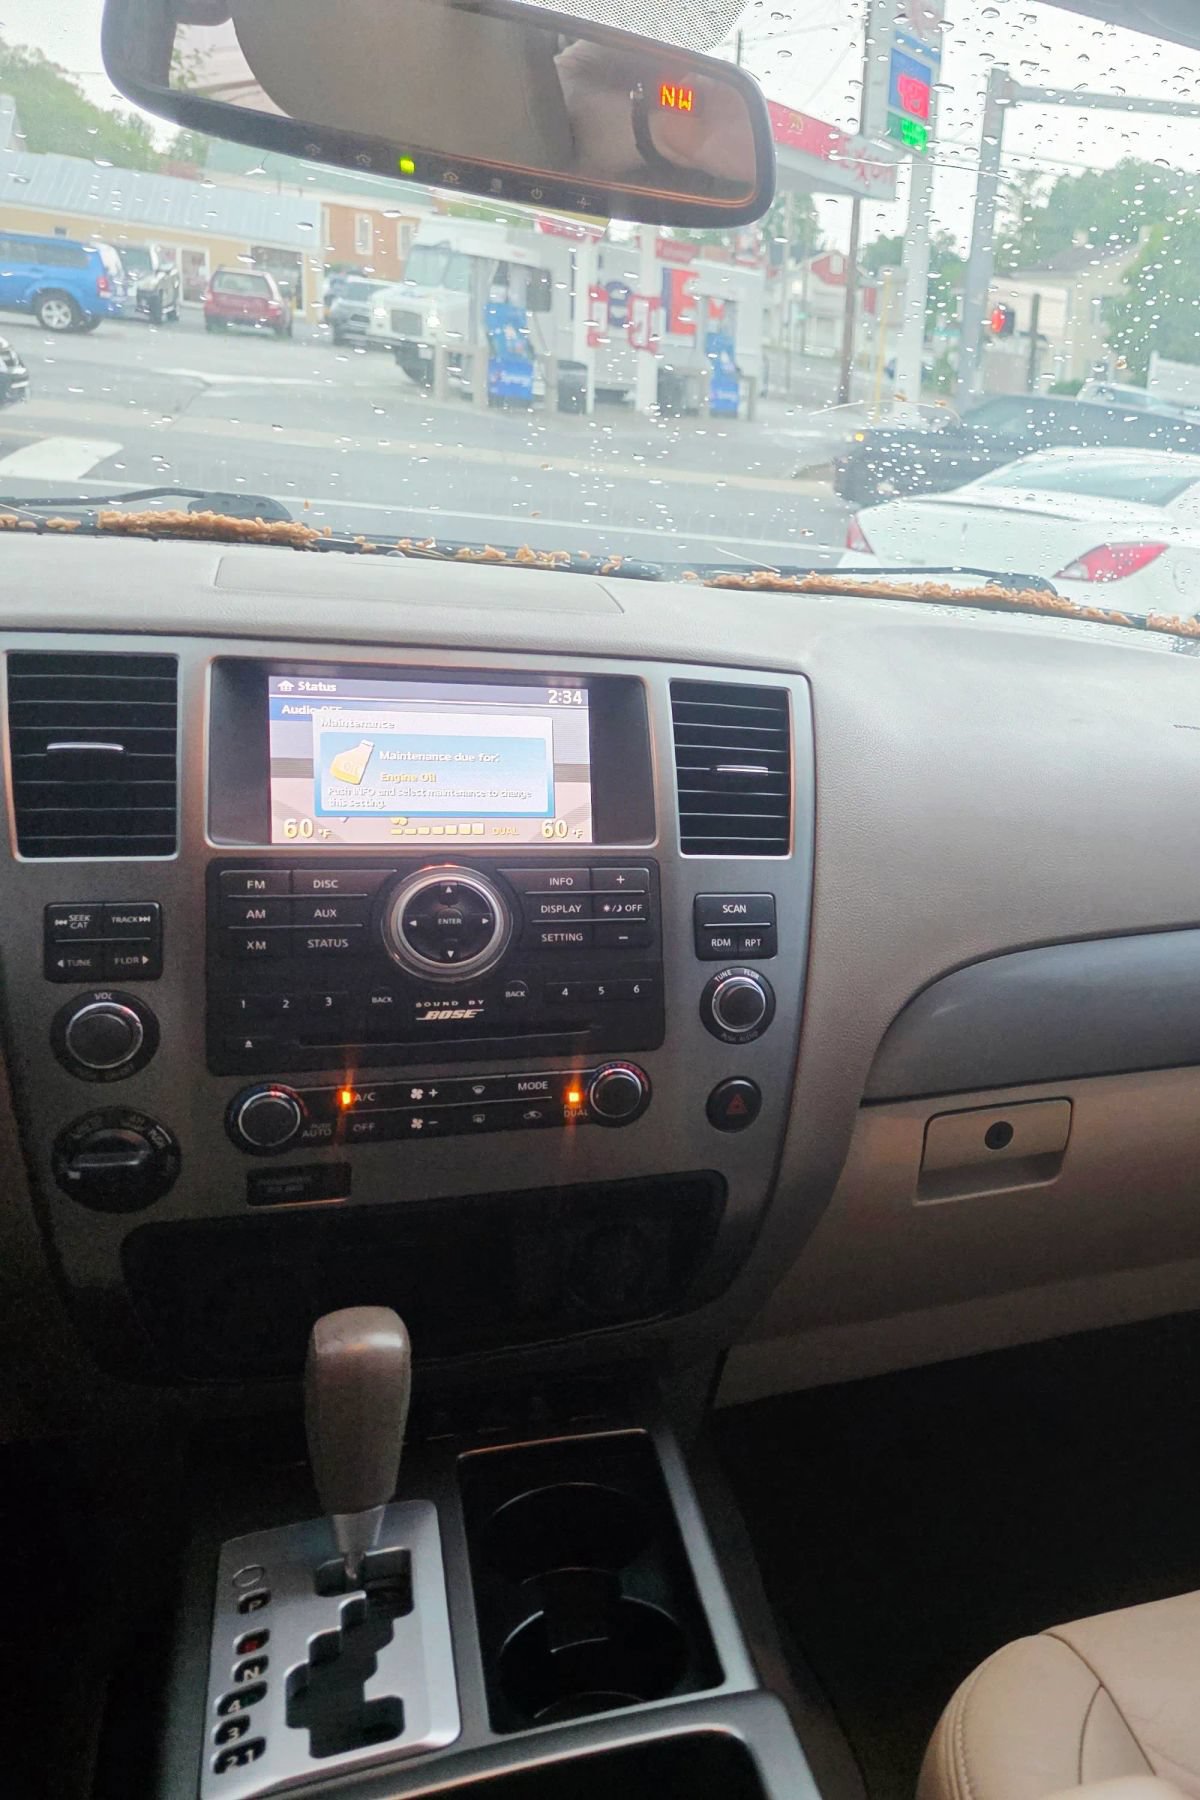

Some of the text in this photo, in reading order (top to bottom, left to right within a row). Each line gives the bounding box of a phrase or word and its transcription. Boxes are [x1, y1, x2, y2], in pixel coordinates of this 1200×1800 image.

[661, 84, 692, 111] NW
[298, 681, 337, 692] Status
[548, 689, 583, 705] 2:34
[281, 704, 315, 715] Audio
[321, 718, 396, 730] Maintenance
[379, 751, 452, 762] Maintenance
[453, 752, 476, 762] due
[380, 773, 437, 784] Engine Oil
[328, 787, 352, 797] Push
[378, 788, 396, 797] and
[399, 788, 427, 798] select
[428, 789, 487, 798] maintenance
[488, 790, 498, 798] to
[500, 790, 533, 800] change
[328, 798, 348, 807] this
[282, 818, 314, 840] 60
[491, 827, 520, 836] DUAL
[540, 818, 569, 840] 60
[246, 880, 266, 890] FM
[312, 879, 339, 889] DISC
[549, 877, 573, 886] INFO
[313, 908, 337, 918] AUX
[540, 904, 582, 914] DISPLAY
[624, 904, 643, 912] OFF
[722, 904, 747, 914] SCAN
[68, 914, 91, 922] SEEK
[246, 909, 266, 919] AM
[111, 916, 138, 924] TRACK
[437, 917, 462, 925] ENTER
[541, 932, 583, 943] SETTING
[246, 940, 267, 950] XM
[307, 938, 349, 948] STATUS
[711, 938, 731, 948] RDM
[745, 938, 762, 948] RPT
[67, 959, 92, 967] TUNE
[714, 970, 732, 982] TUNE
[505, 990, 526, 998] BACK
[562, 987, 568, 996] 4
[599, 986, 604, 995] 5
[633, 985, 640, 994] 6
[241, 1000, 246, 1008] 1
[283, 1000, 289, 1008] 2
[325, 997, 332, 1006] 3
[371, 996, 393, 1004] BACK
[415, 1000, 460, 1008] SOUND
[416, 1008, 485, 1021] BOSE
[518, 1081, 549, 1092] MODE
[355, 1092, 376, 1102] A/C
[563, 1109, 588, 1118] DUAL
[302, 1127, 332, 1138] AUTO
[352, 1123, 375, 1133] OFF
[243, 1666, 260, 1681] N
[227, 1700, 241, 1713] 4
[227, 1727, 240, 1741] 3
